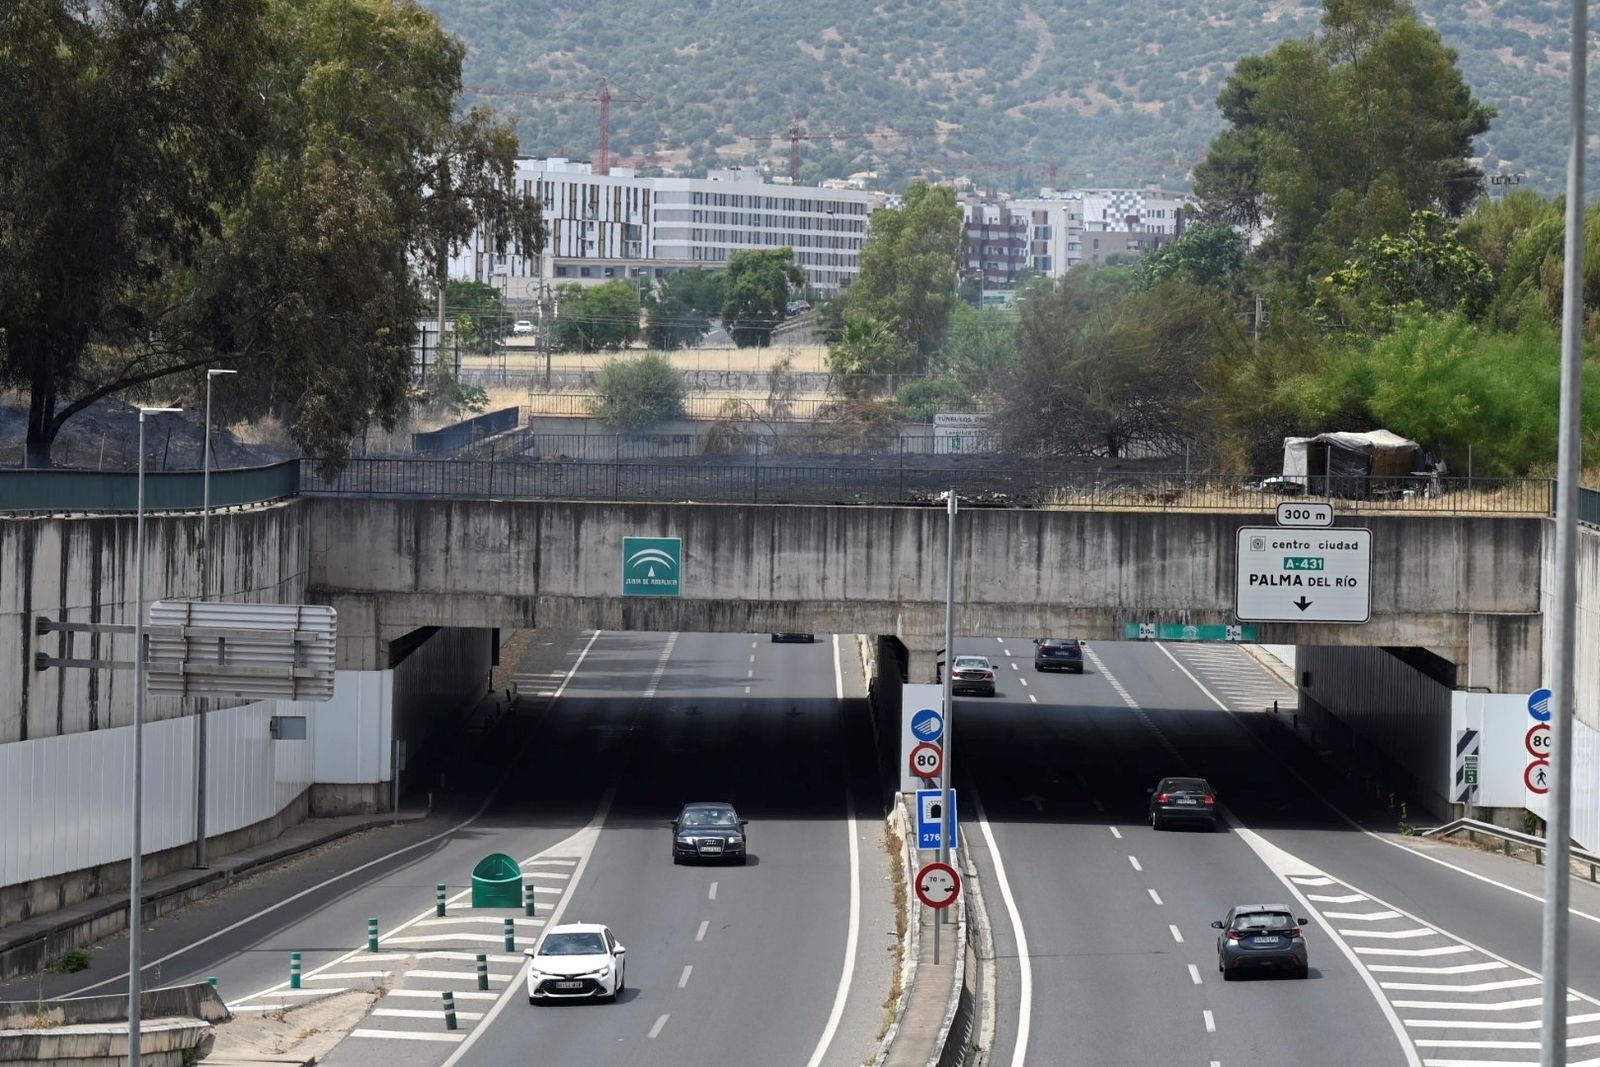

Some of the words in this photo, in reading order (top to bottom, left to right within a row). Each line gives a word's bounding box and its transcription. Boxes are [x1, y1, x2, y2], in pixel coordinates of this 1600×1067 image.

[1284, 509, 1310, 520] 300
[1315, 512, 1326, 520] m
[1272, 540, 1310, 549] centro
[1318, 540, 1359, 550] ciudad
[1286, 559, 1323, 569] A-431
[1249, 574, 1303, 586] PALMA
[1308, 577, 1331, 587] DEL
[1335, 575, 1357, 587] RÍO
[1533, 735, 1551, 747] 80
[917, 755, 937, 767] 80
[922, 833, 941, 842] 276
